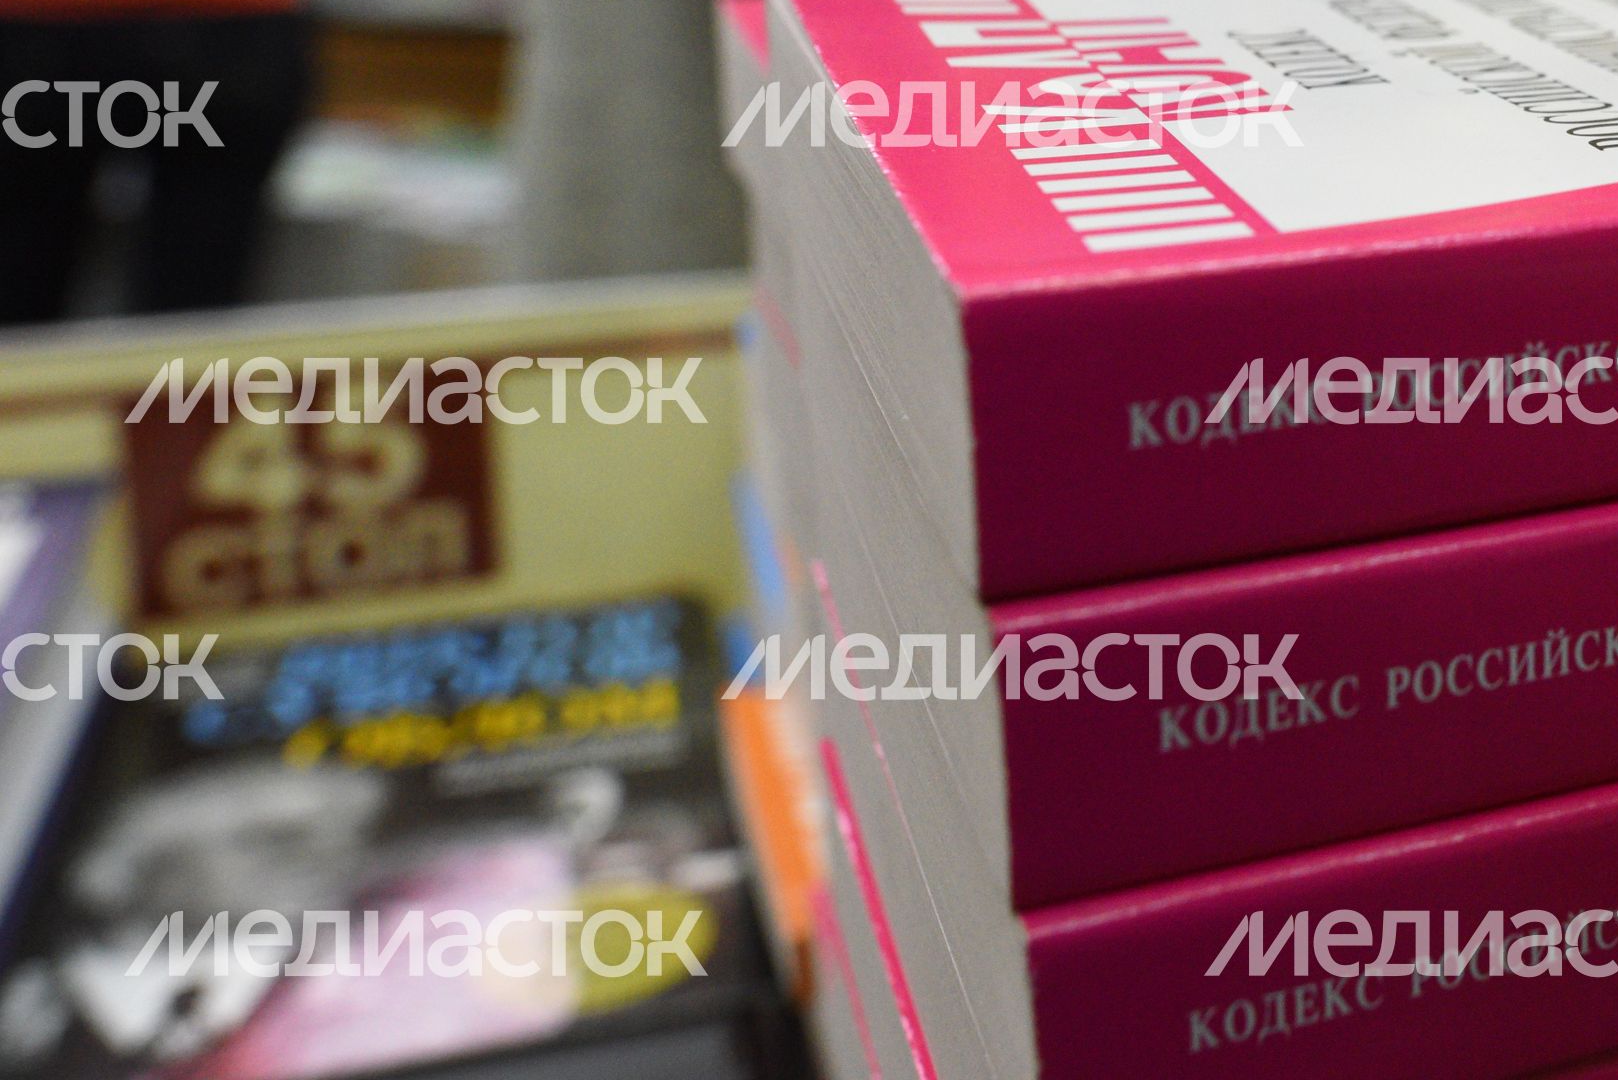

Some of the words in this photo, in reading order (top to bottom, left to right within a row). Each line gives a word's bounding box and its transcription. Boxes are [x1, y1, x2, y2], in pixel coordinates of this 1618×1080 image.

[1226, 28, 1392, 90] КОДЕКС
[1127, 377, 1337, 451] КОДЕКС
[1157, 675, 1361, 754] КОДЕКС
[1186, 966, 1388, 1054] КОДЕКС
